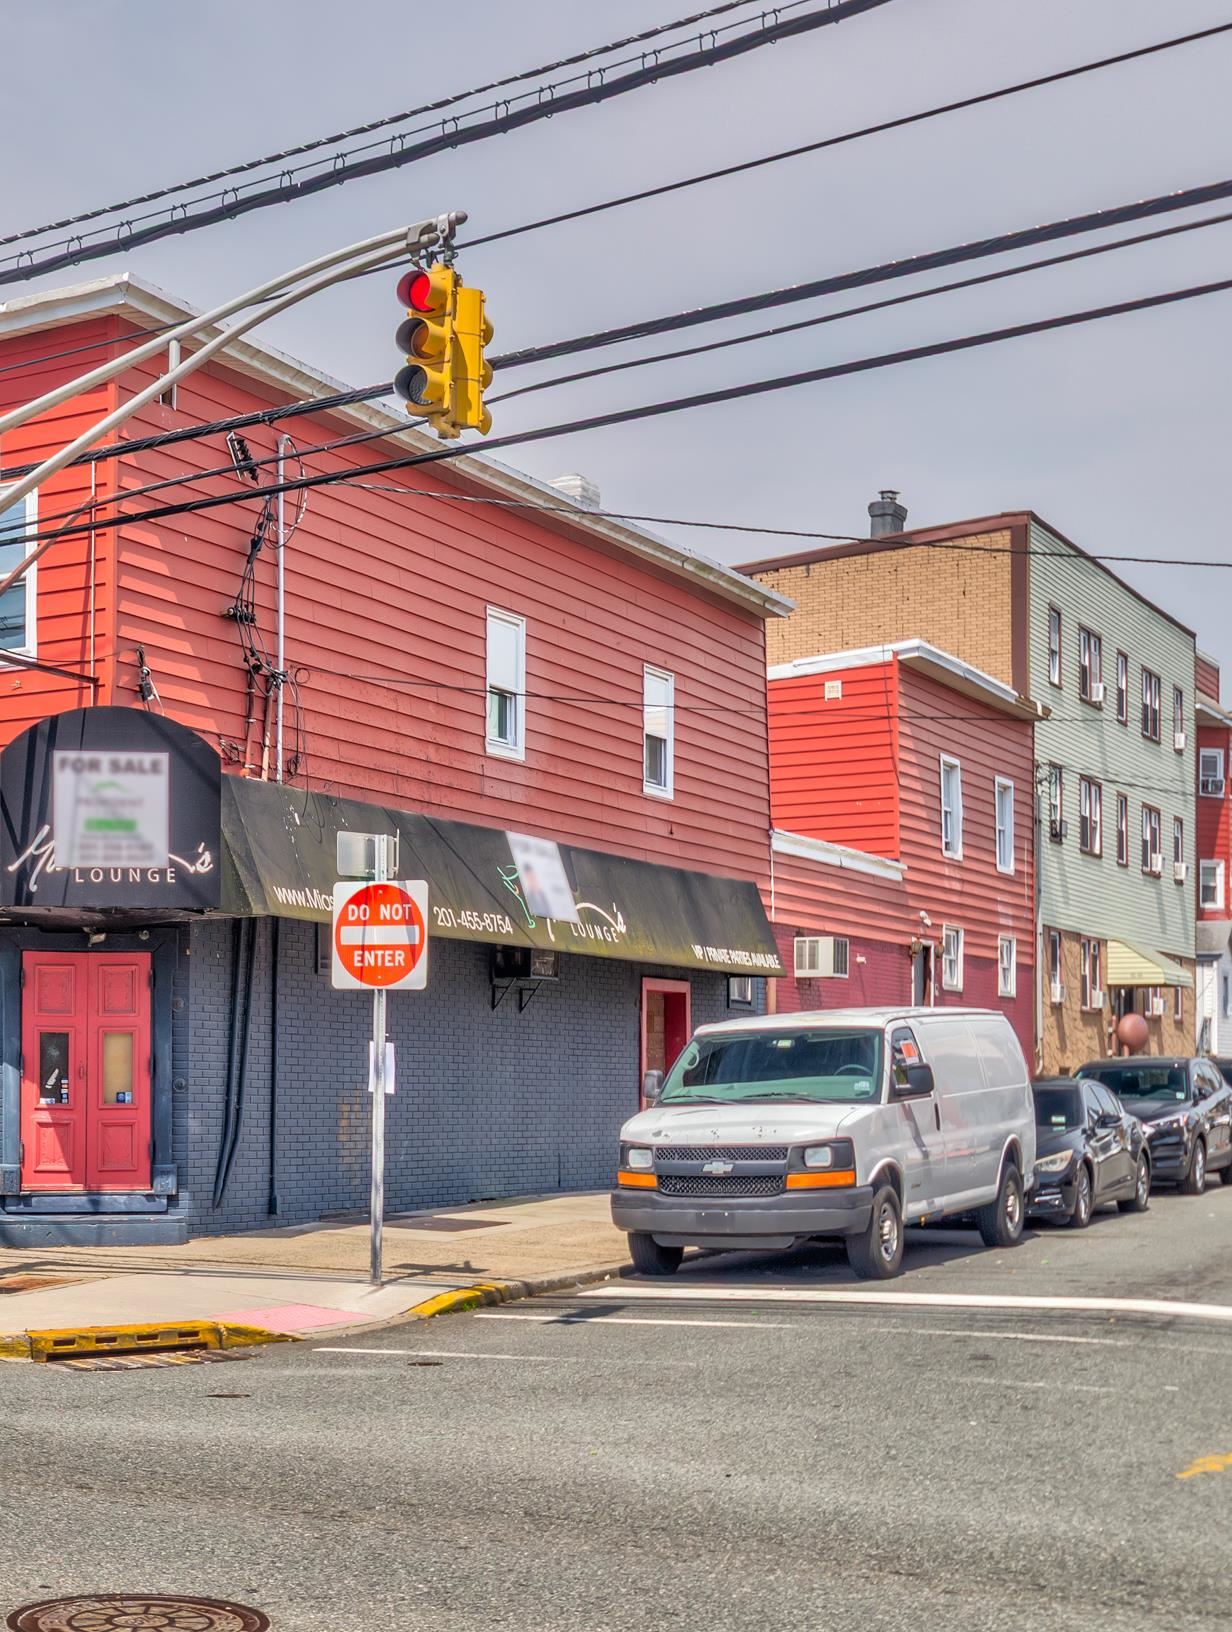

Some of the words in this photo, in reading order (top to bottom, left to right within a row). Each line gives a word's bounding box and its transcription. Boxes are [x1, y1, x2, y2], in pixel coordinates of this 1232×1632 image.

[75, 868, 176, 883] LOUNGE
[348, 904, 370, 921] DO
[380, 904, 412, 921] NOT
[433, 906, 514, 935] 201-455-8754
[570, 921, 620, 943] LOUNGE
[353, 950, 406, 967] ENTER
